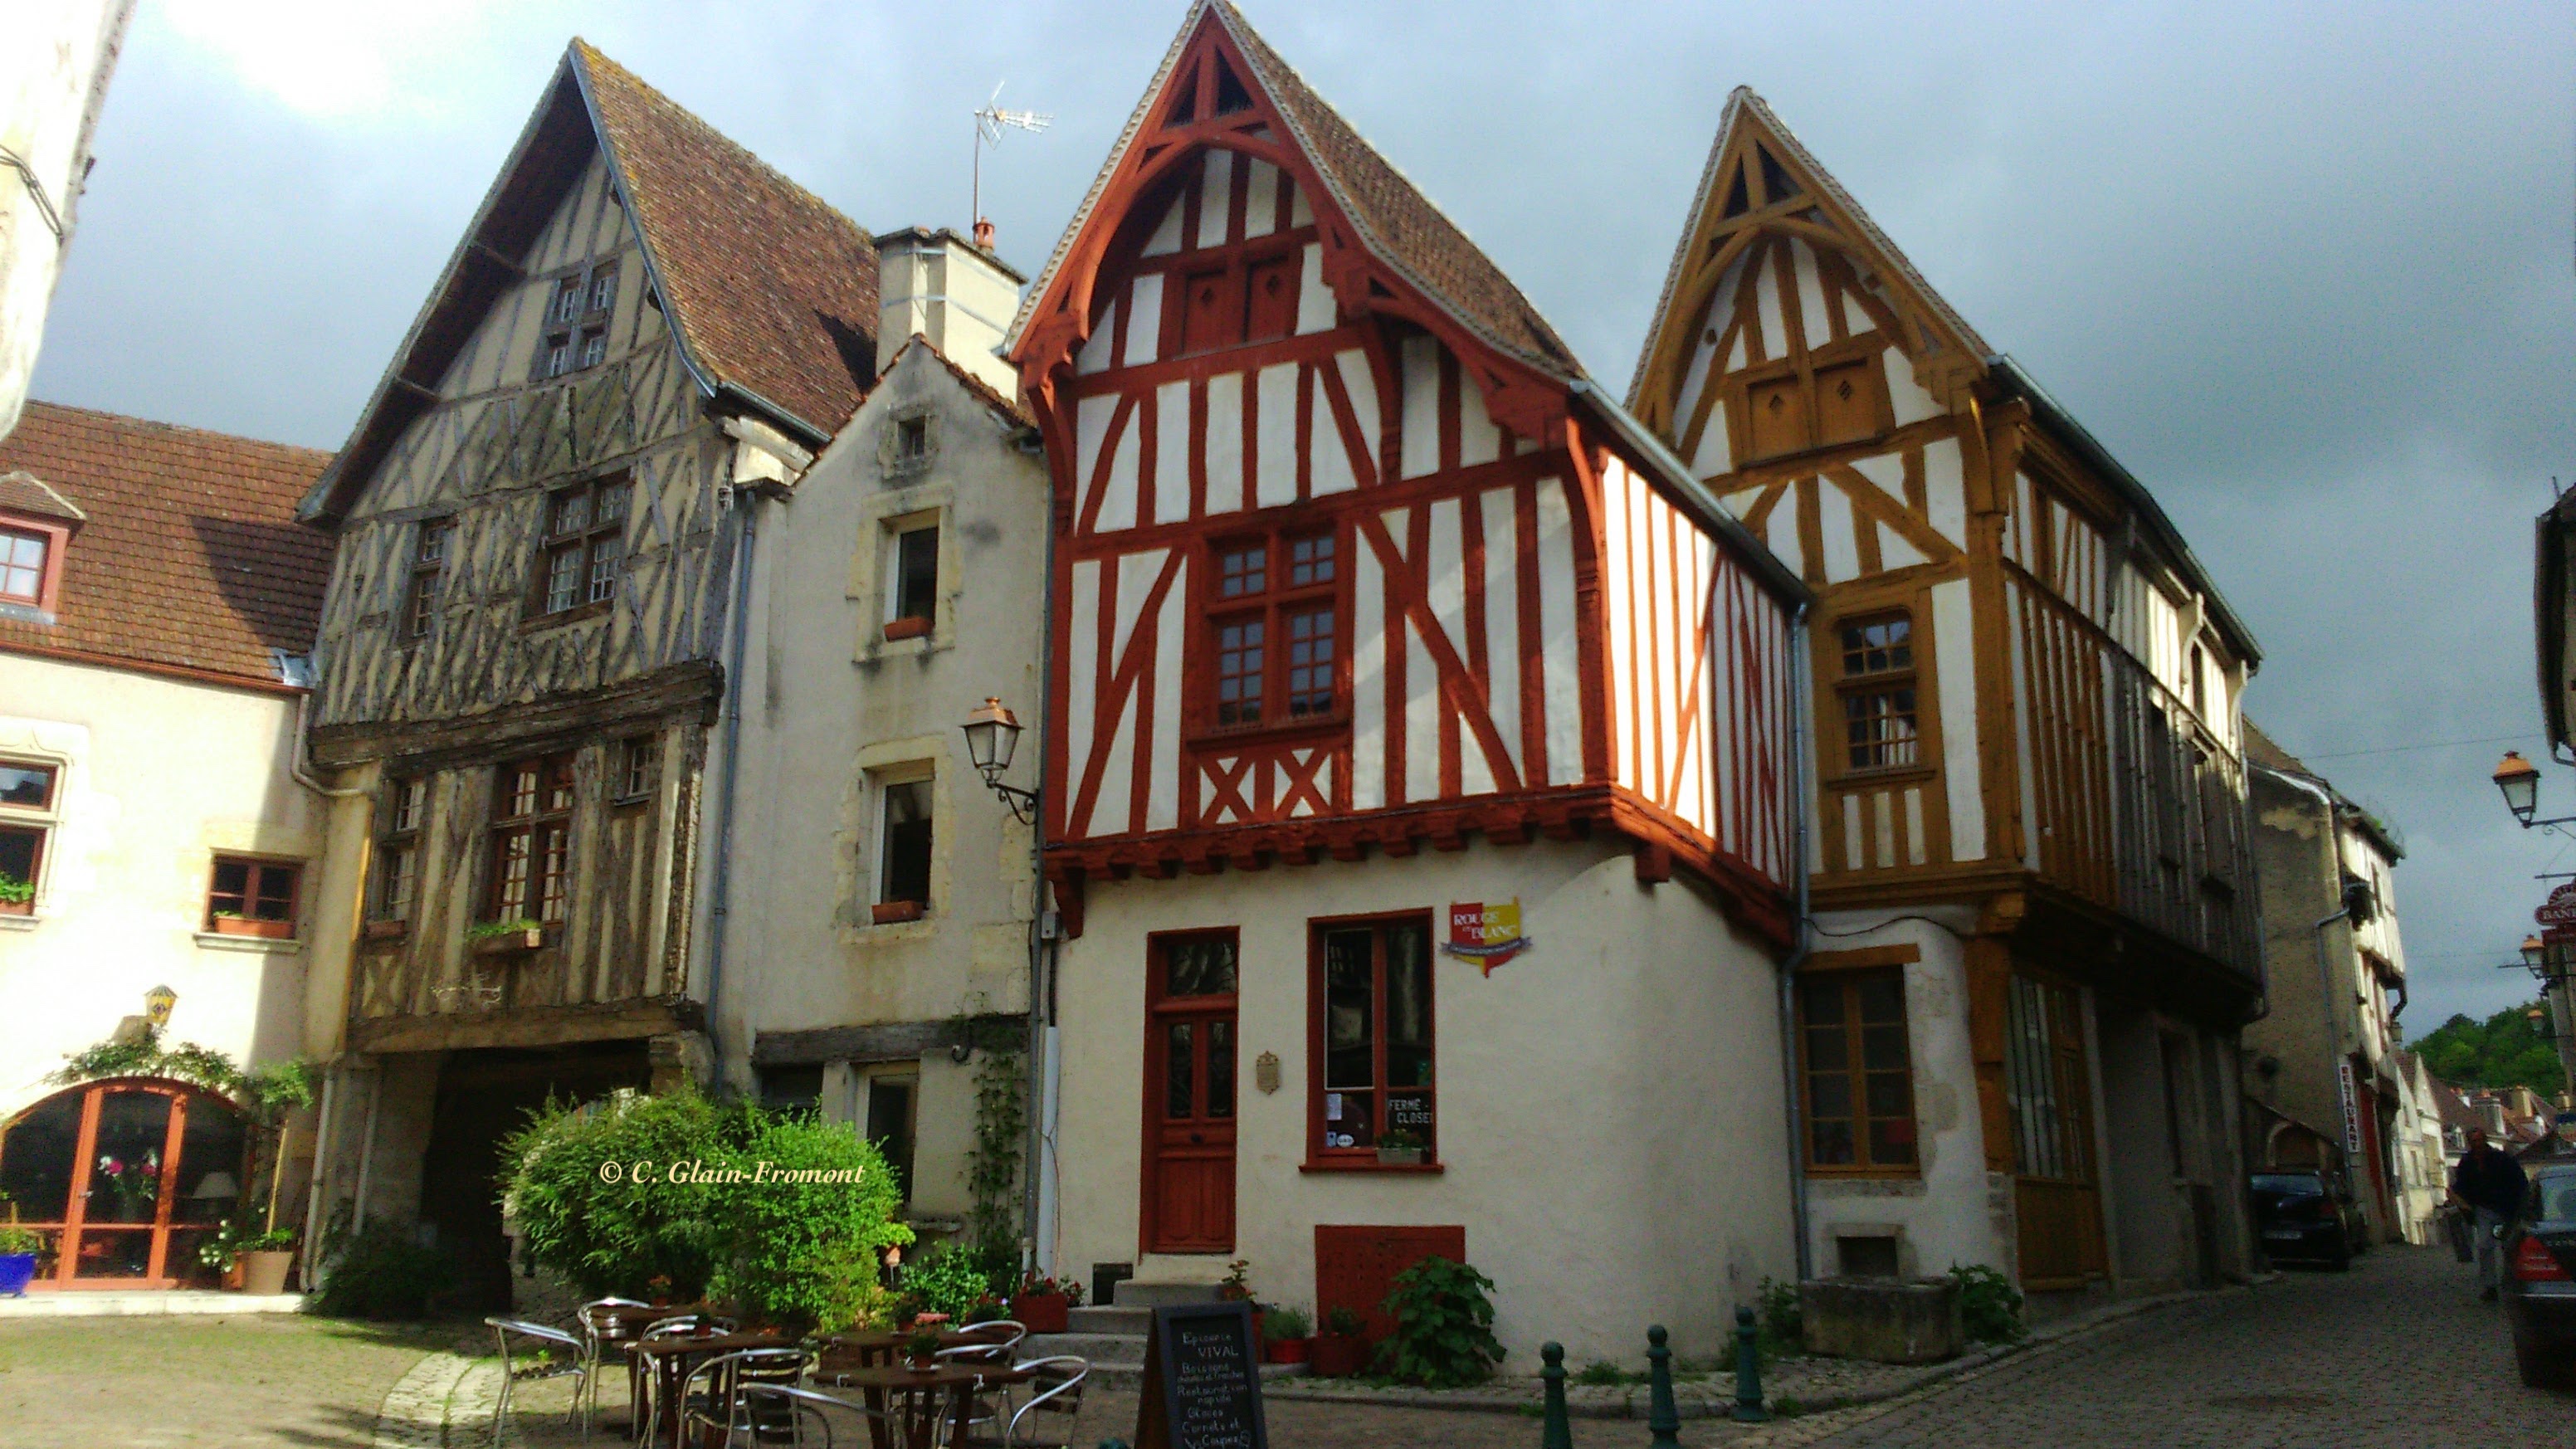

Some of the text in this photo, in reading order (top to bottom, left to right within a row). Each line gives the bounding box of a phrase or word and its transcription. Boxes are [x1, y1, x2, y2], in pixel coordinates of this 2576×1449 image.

[1454, 911, 1499, 925] ROUGE
[1471, 925, 1516, 939] BLANC
[2341, 1066, 2357, 1150] RESTAURANT
[1198, 1345, 1239, 1358] VIVAL
